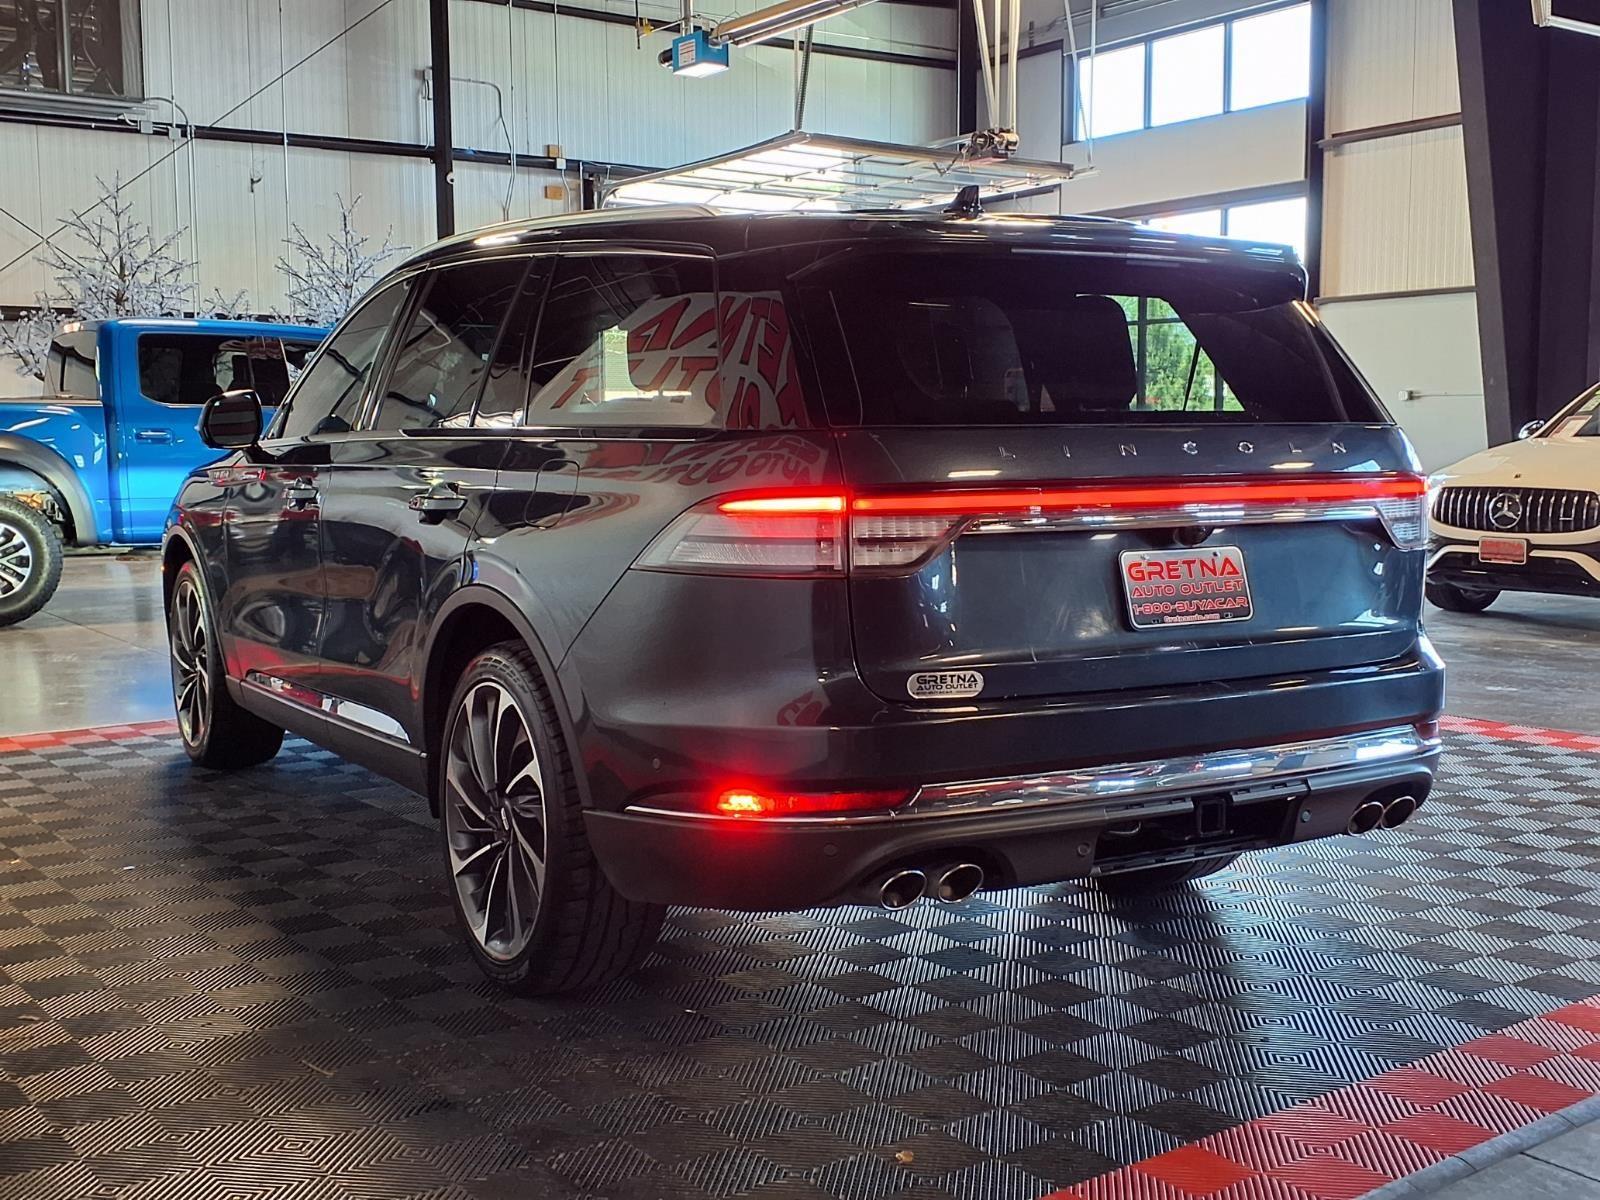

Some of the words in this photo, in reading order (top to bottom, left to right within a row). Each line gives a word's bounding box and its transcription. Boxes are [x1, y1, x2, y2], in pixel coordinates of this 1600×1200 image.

[998, 440, 1347, 459] LINCOLN
[1127, 557, 1240, 582] GRETNA
[1131, 585, 1175, 598] AUTO
[1180, 579, 1244, 594] OUTLET
[1132, 597, 1248, 615] 1-800-BUYACAR
[916, 673, 978, 685] GRETNA
